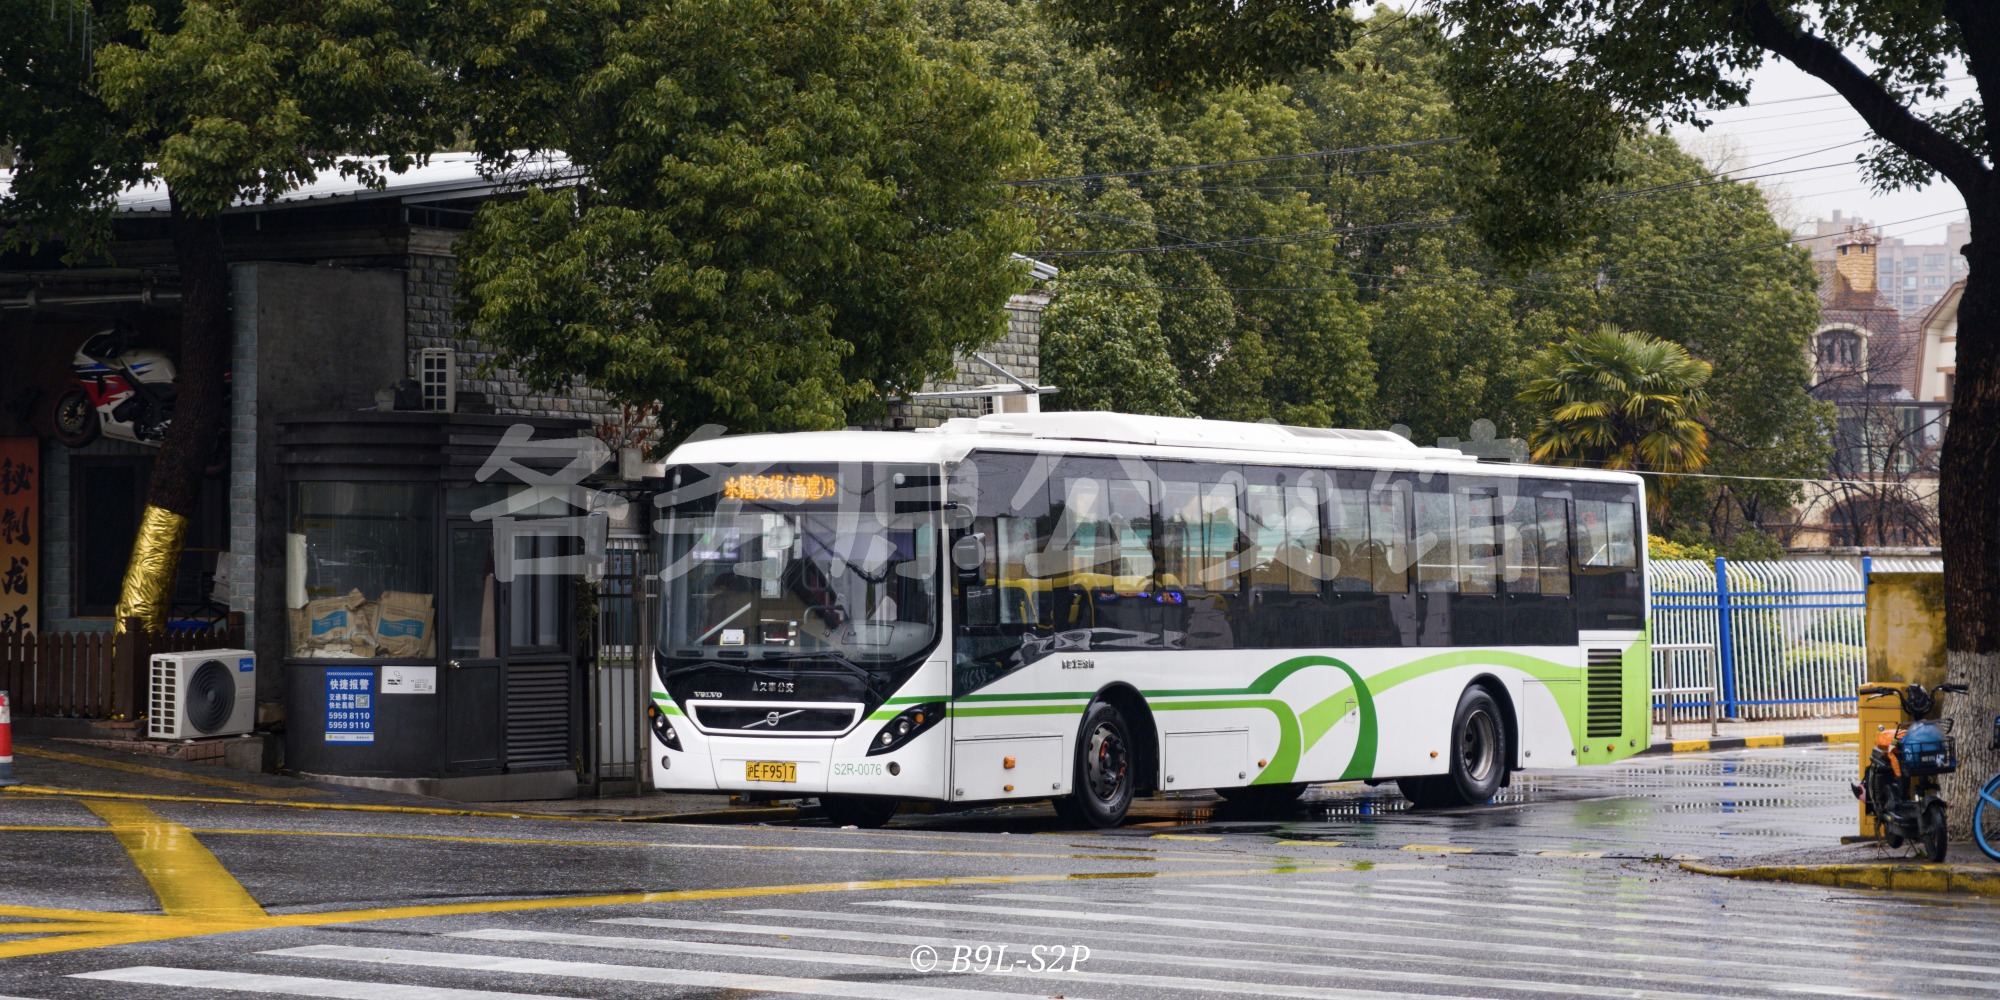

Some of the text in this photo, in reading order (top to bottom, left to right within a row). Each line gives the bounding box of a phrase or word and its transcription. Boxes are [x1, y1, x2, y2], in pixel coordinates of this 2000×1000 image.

[329, 678, 370, 691] 快捷报警
[329, 693, 355, 701] 交通事故
[328, 711, 370, 720] 5959 8110
[328, 721, 370, 729] 5959 9110
[833, 763, 882, 776] S2R-0076
